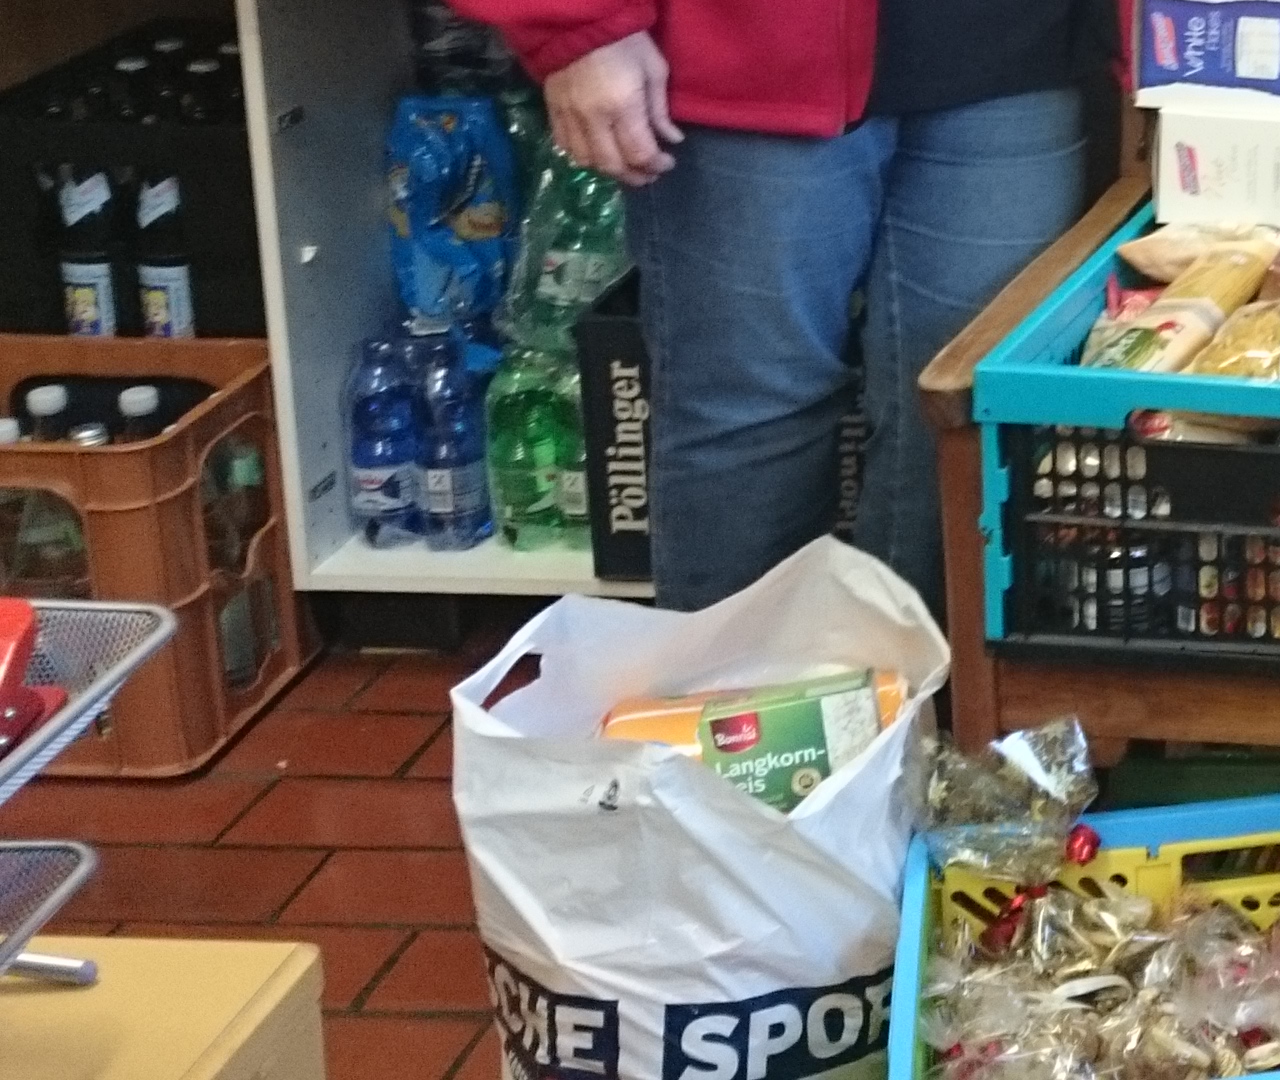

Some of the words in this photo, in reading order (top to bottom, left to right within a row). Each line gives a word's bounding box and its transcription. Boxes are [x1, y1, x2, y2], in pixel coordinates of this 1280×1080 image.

[1183, 16, 1206, 79] White
[606, 359, 650, 535] Pöllinger
[715, 747, 826, 779] Langkorn-
[735, 776, 767, 794] eis
